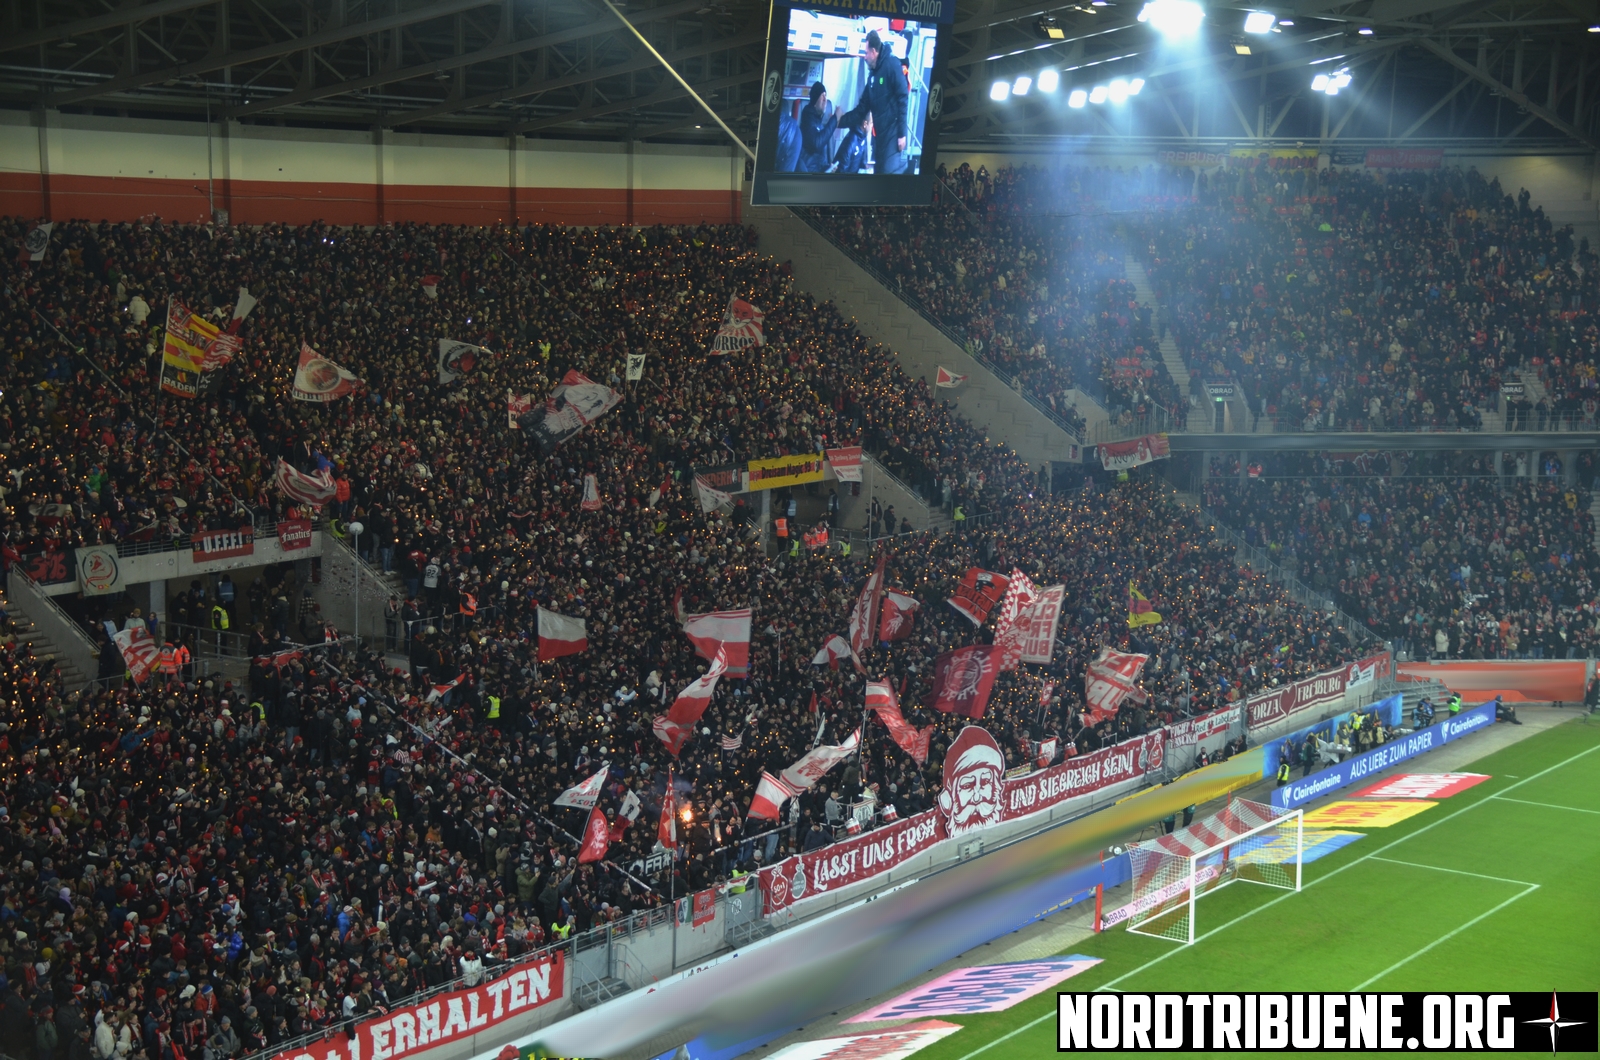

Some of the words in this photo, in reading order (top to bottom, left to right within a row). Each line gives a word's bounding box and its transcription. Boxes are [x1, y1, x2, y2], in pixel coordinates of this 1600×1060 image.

[902, 0, 942, 18] Stadion
[1158, 150, 1224, 164] FREIBURG
[163, 376, 196, 394] BADEN
[762, 465, 786, 479] Dreisam
[787, 462, 803, 478] Magic
[203, 531, 243, 554] U.F.F.F.!
[281, 529, 311, 543] Fanatics
[1248, 698, 1280, 722] FORZA
[1297, 675, 1341, 703] FREIBURG
[1195, 723, 1206, 733] Red
[1215, 712, 1229, 727] Label
[1450, 713, 1489, 736] Clairefontaine
[1293, 773, 1341, 801] Clairefontaine
[1350, 757, 1367, 780] AUS
[1368, 752, 1388, 773] LIEBE
[1389, 743, 1407, 764] ZUM
[1408, 731, 1432, 757] PAPIER
[1010, 783, 1037, 810] UND
[1039, 762, 1101, 801] SIEGREICH
[1102, 749, 1134, 778] SEIN!
[813, 849, 860, 892] LASST
[862, 836, 895, 869] UNS
[897, 815, 938, 855] FROH
[1194, 867, 1214, 883] OBRAD
[370, 962, 552, 1060] ERHALTEN
